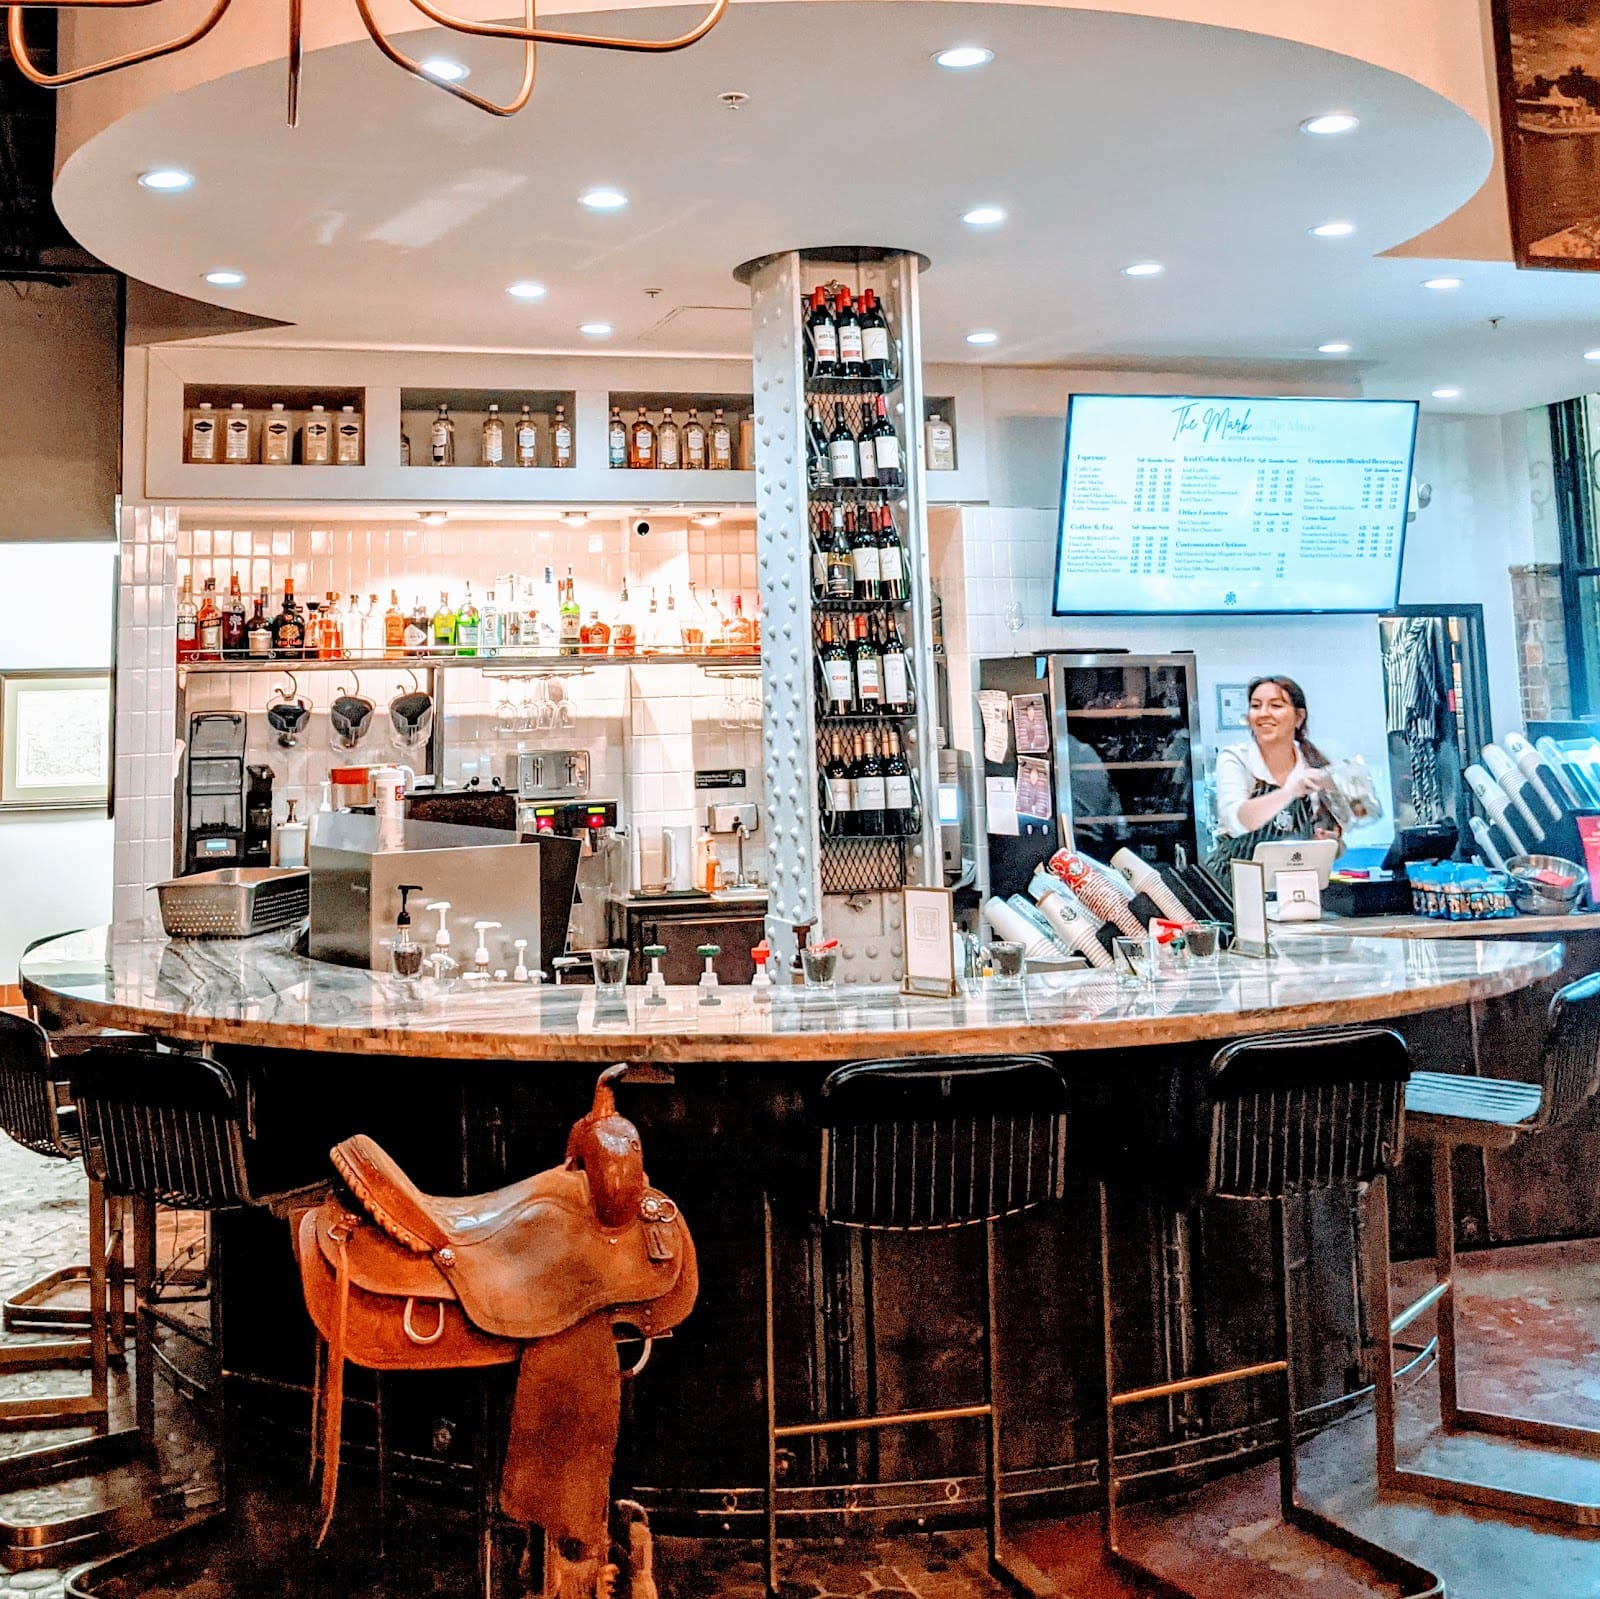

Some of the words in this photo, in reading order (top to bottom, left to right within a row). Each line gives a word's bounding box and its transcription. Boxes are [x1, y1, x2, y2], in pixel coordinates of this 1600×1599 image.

[1171, 401, 1200, 442] The
[1202, 407, 1253, 443] Mark
[1371, 457, 1403, 465] Beverages
